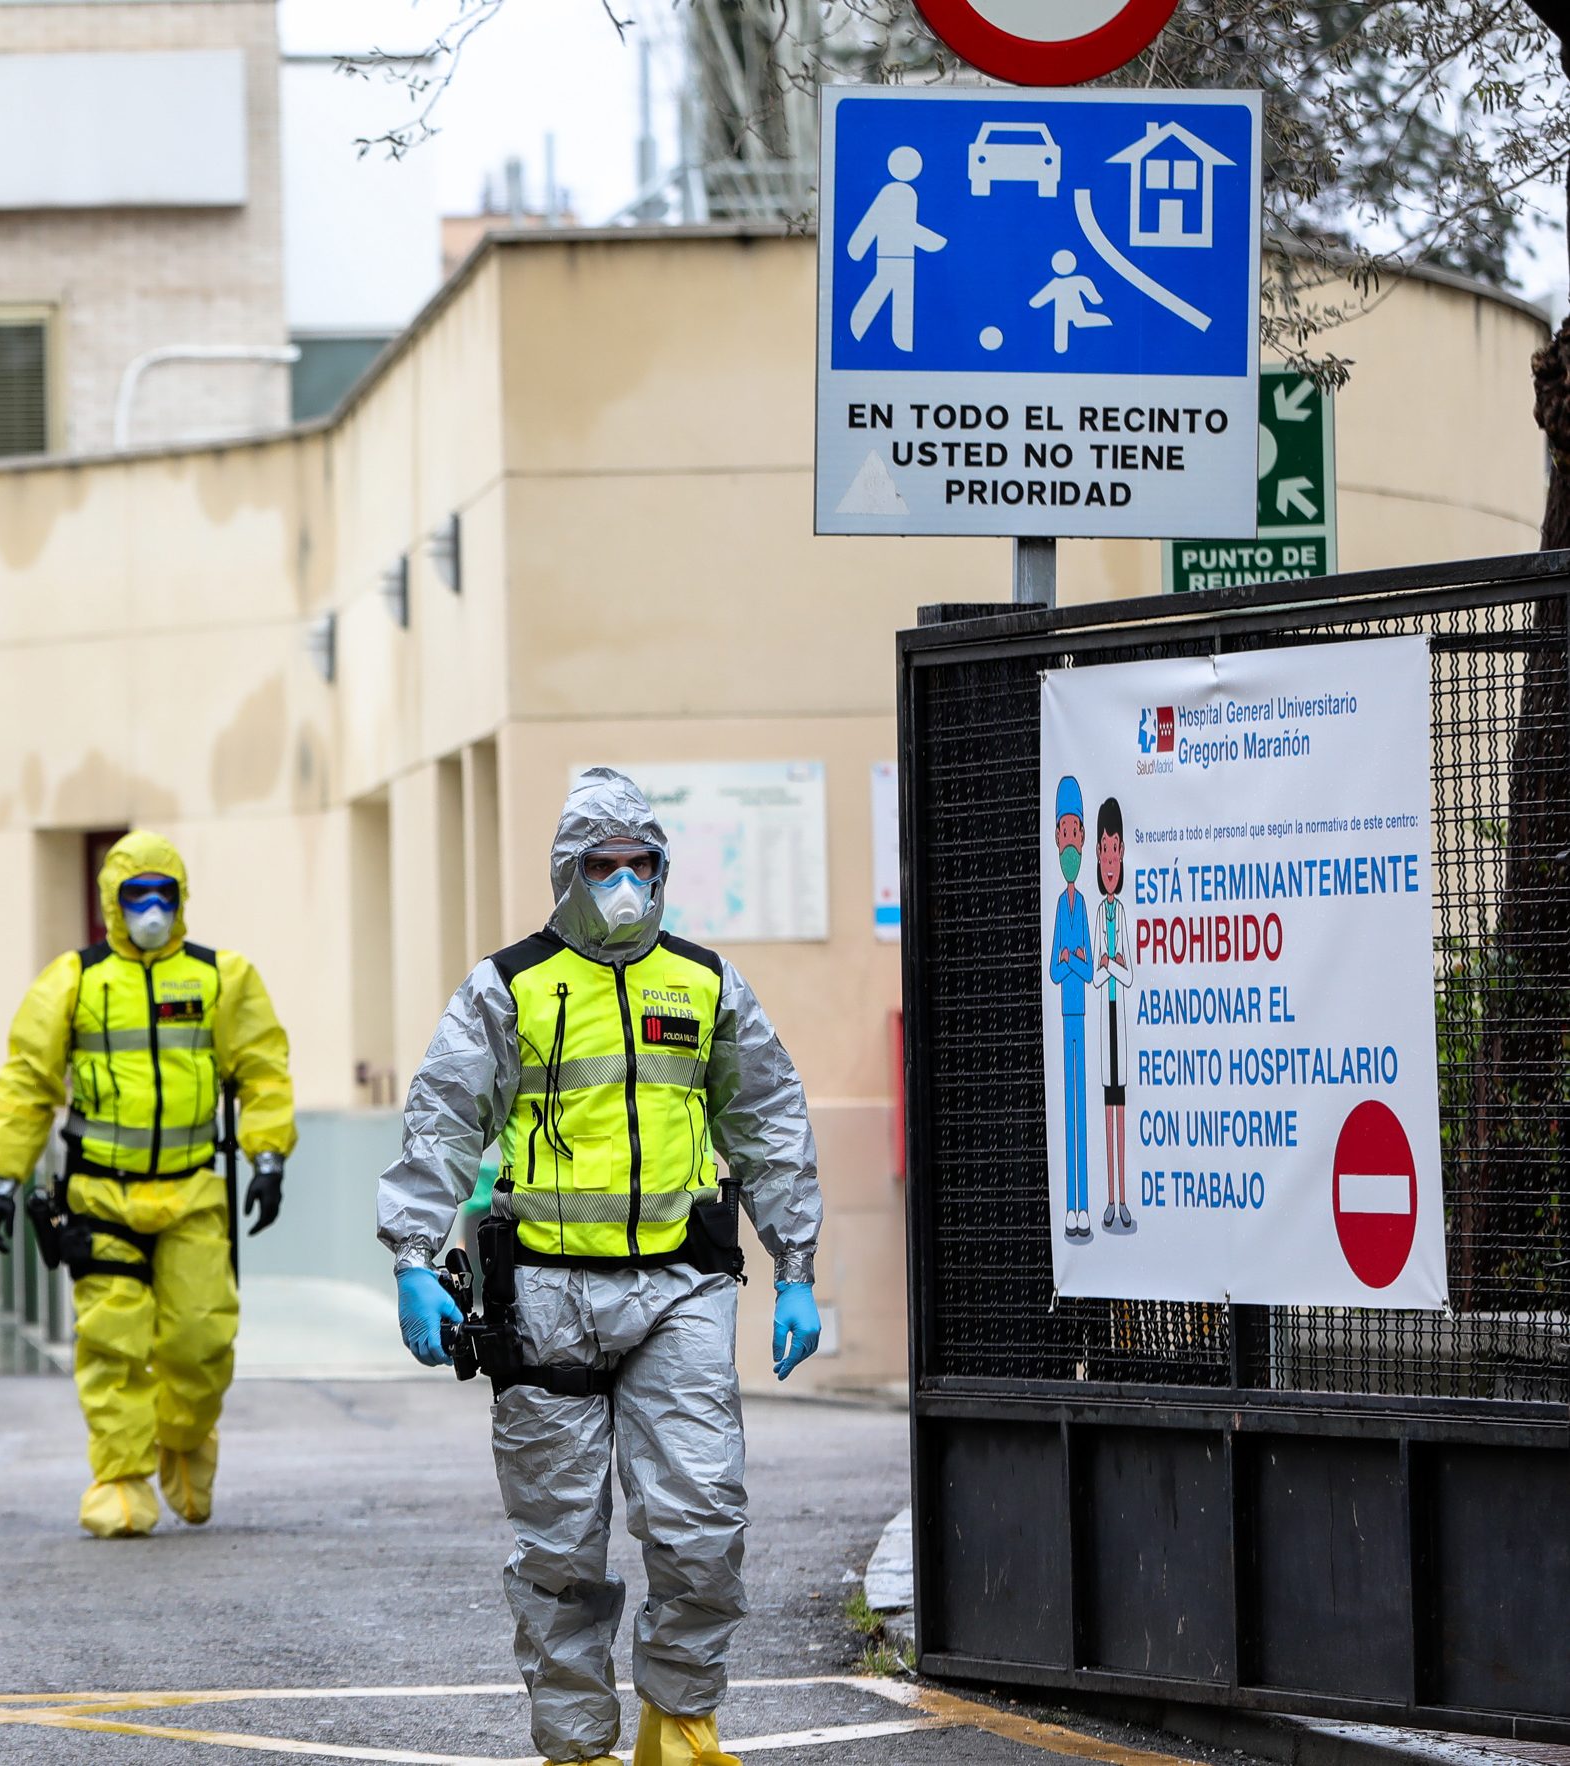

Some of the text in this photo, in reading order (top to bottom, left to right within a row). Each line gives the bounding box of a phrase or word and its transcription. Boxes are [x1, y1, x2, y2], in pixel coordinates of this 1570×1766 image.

[847, 403, 1229, 434] EN TODO EL RECINTO
[892, 441, 1185, 471] USTED NO TIENE
[945, 479, 1132, 507] PRIORIDAD
[1181, 545, 1318, 571] PUNTO DE
[1178, 691, 1358, 730] Hospital General Universitario
[1178, 728, 1310, 769] Gregorio Marañón
[1135, 813, 1418, 843] Se recuerda a todo el personal que según la normativa de este centro:
[1135, 854, 1419, 905] ESTÁ TERMINANTEMENTE
[1136, 912, 1283, 966] PROHIBIDO
[642, 989, 691, 1004] POLICIA
[644, 1006, 694, 1020] MILITAR
[1137, 986, 1296, 1026] ABANDONAR EL
[1138, 1045, 1398, 1086] RECINTO HOSPITALARIO
[1140, 1109, 1298, 1148] CON UNIFORME
[1141, 1171, 1265, 1210] DE TRABAJO
